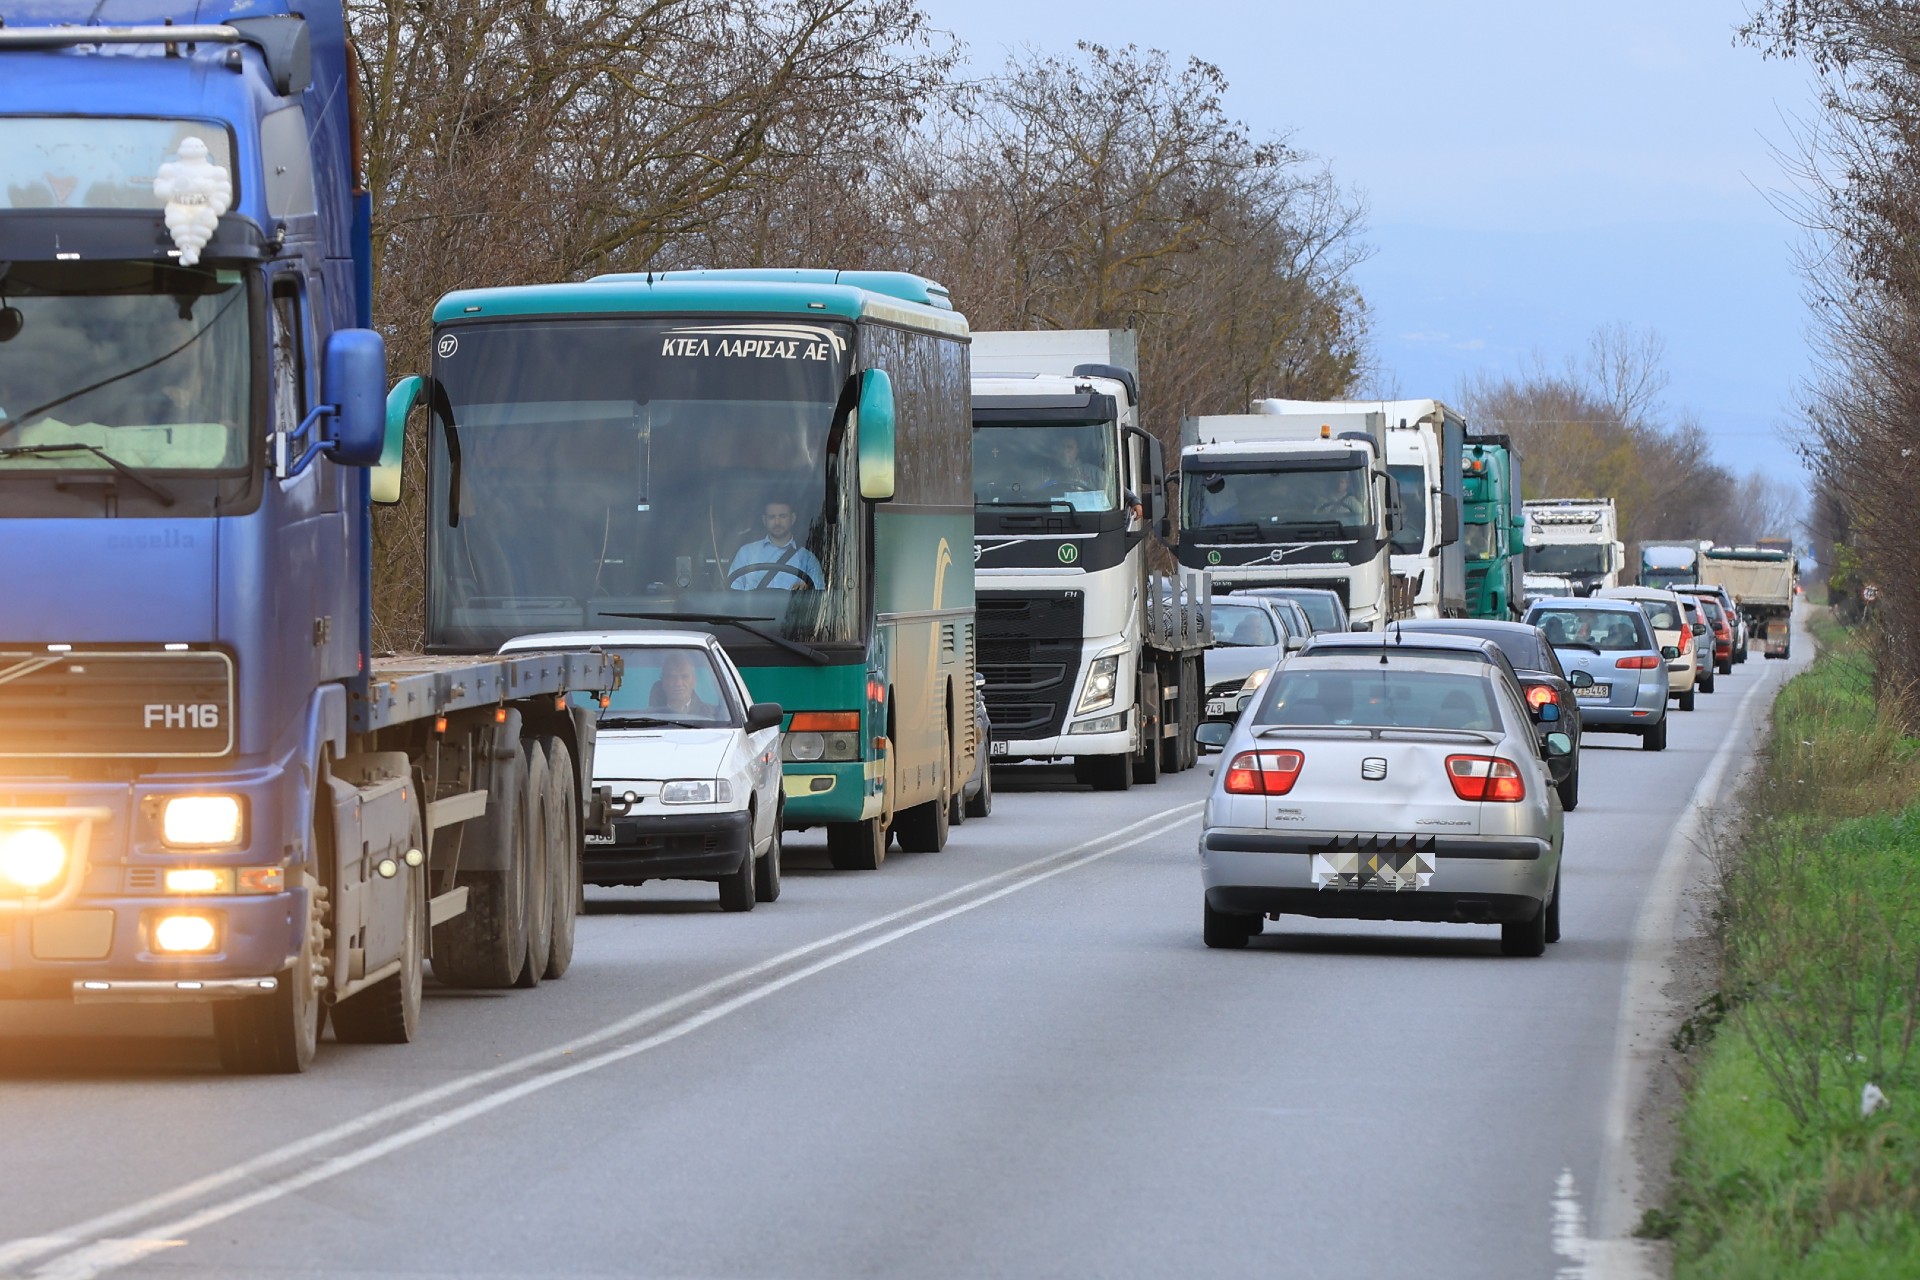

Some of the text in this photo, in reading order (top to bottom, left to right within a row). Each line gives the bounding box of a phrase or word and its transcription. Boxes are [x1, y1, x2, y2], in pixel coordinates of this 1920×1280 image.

[440, 340, 455, 352] 97
[661, 338, 830, 361] ΚΤΕΛ ΛΑΡΙΣΑΣ ΑΕ
[107, 528, 194, 549] casella
[1061, 548, 1073, 559] VI
[144, 704, 219, 728] FH16
